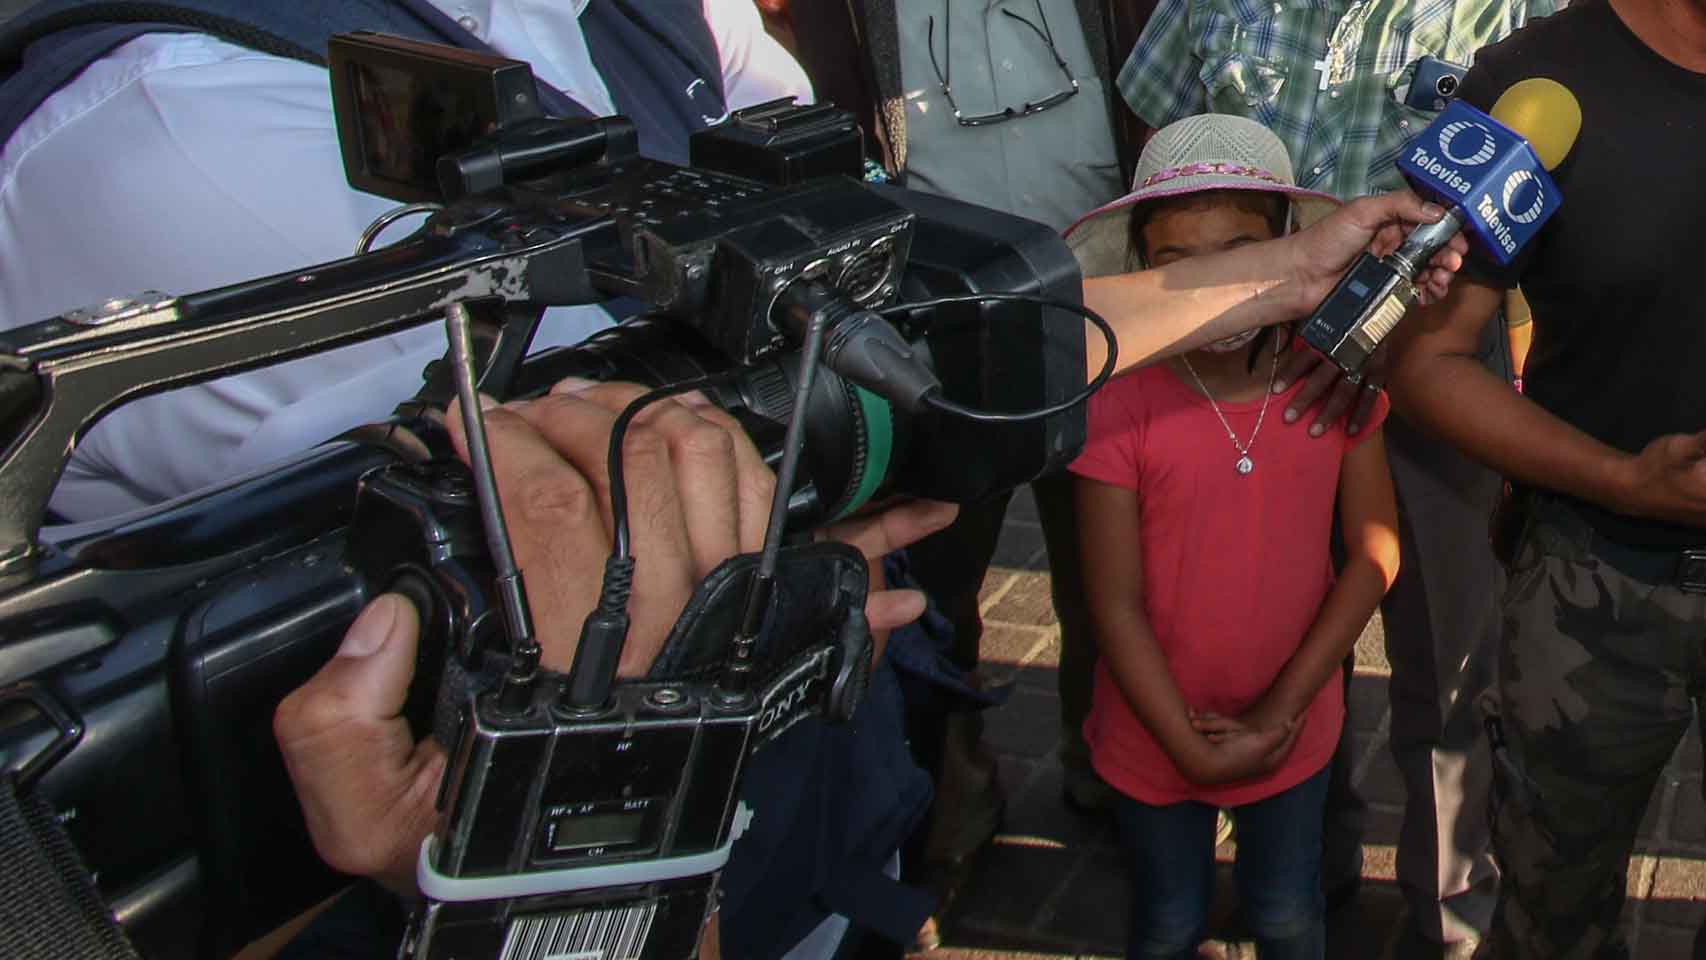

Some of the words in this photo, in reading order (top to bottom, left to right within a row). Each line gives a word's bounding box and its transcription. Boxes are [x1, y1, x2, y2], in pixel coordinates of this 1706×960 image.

[1410, 146, 1472, 195] Televisa
[1477, 193, 1517, 255] Televisa
[758, 679, 811, 733] ONY
